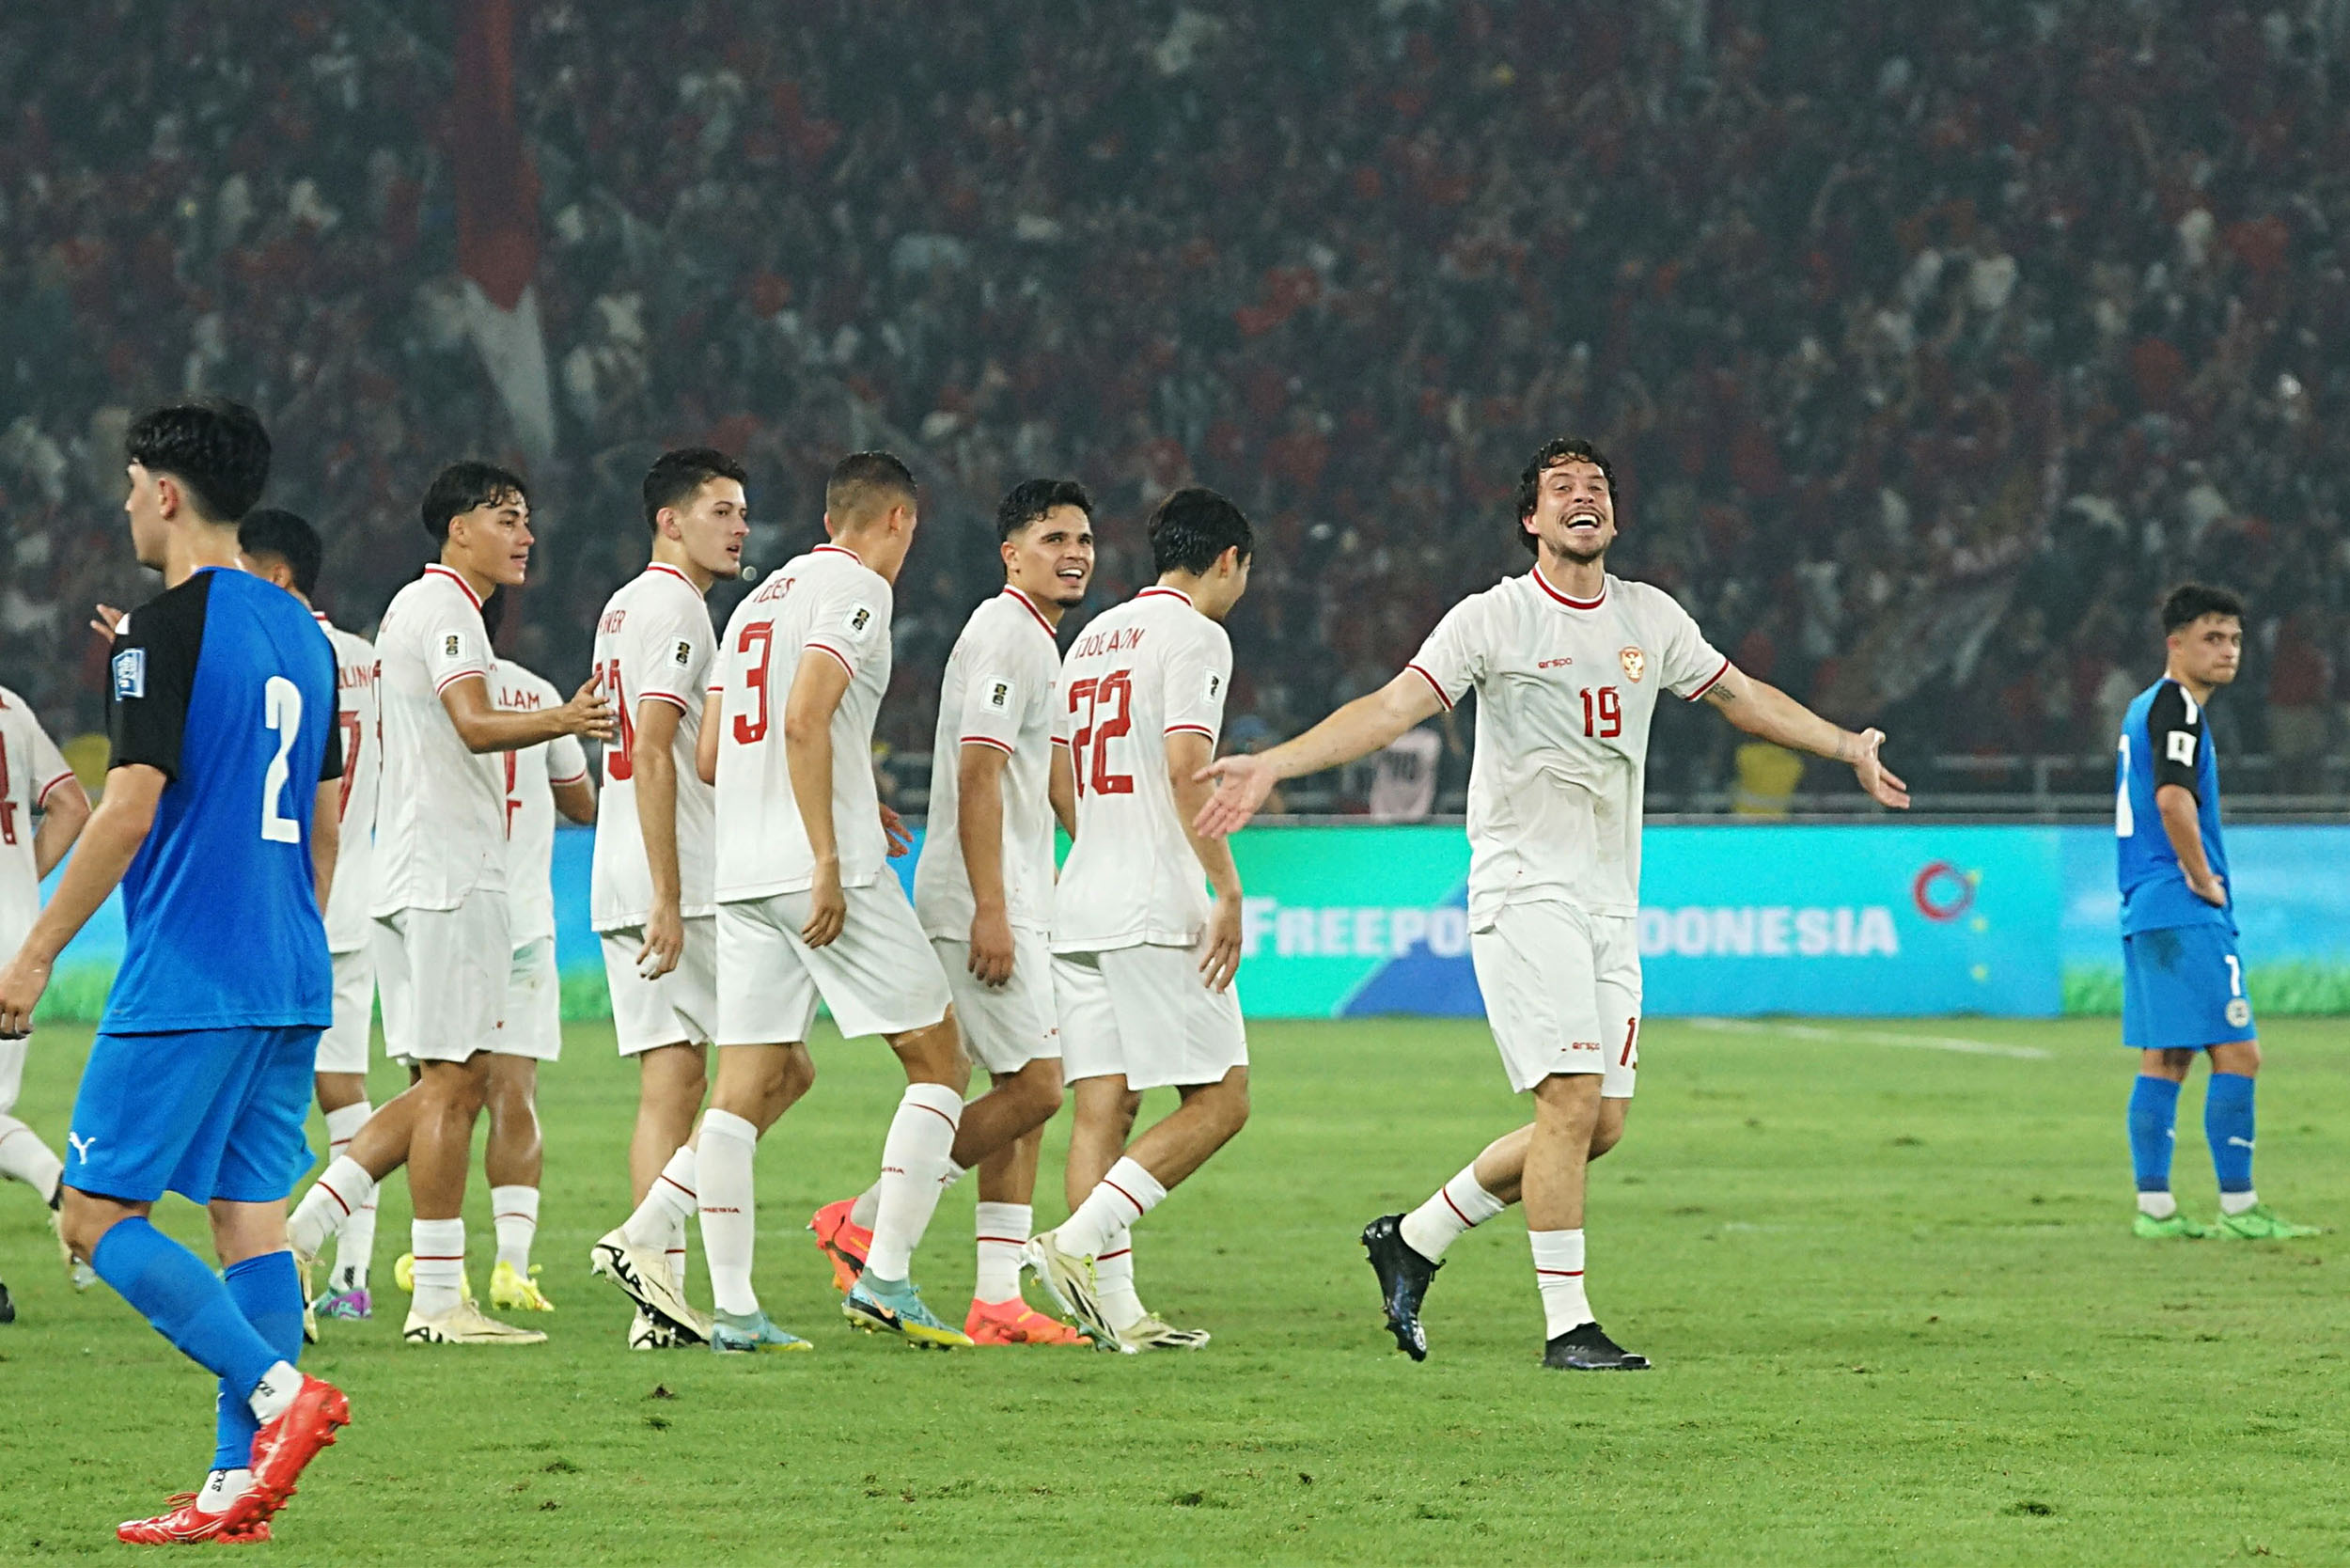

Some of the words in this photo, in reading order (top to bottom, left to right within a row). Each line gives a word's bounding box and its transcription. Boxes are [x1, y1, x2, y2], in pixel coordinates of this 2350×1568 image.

[498, 686, 540, 710] LAM
[733, 618, 776, 745] 3
[1069, 668, 1134, 799] 22
[1579, 685, 1622, 738] 19
[261, 675, 304, 843] 2
